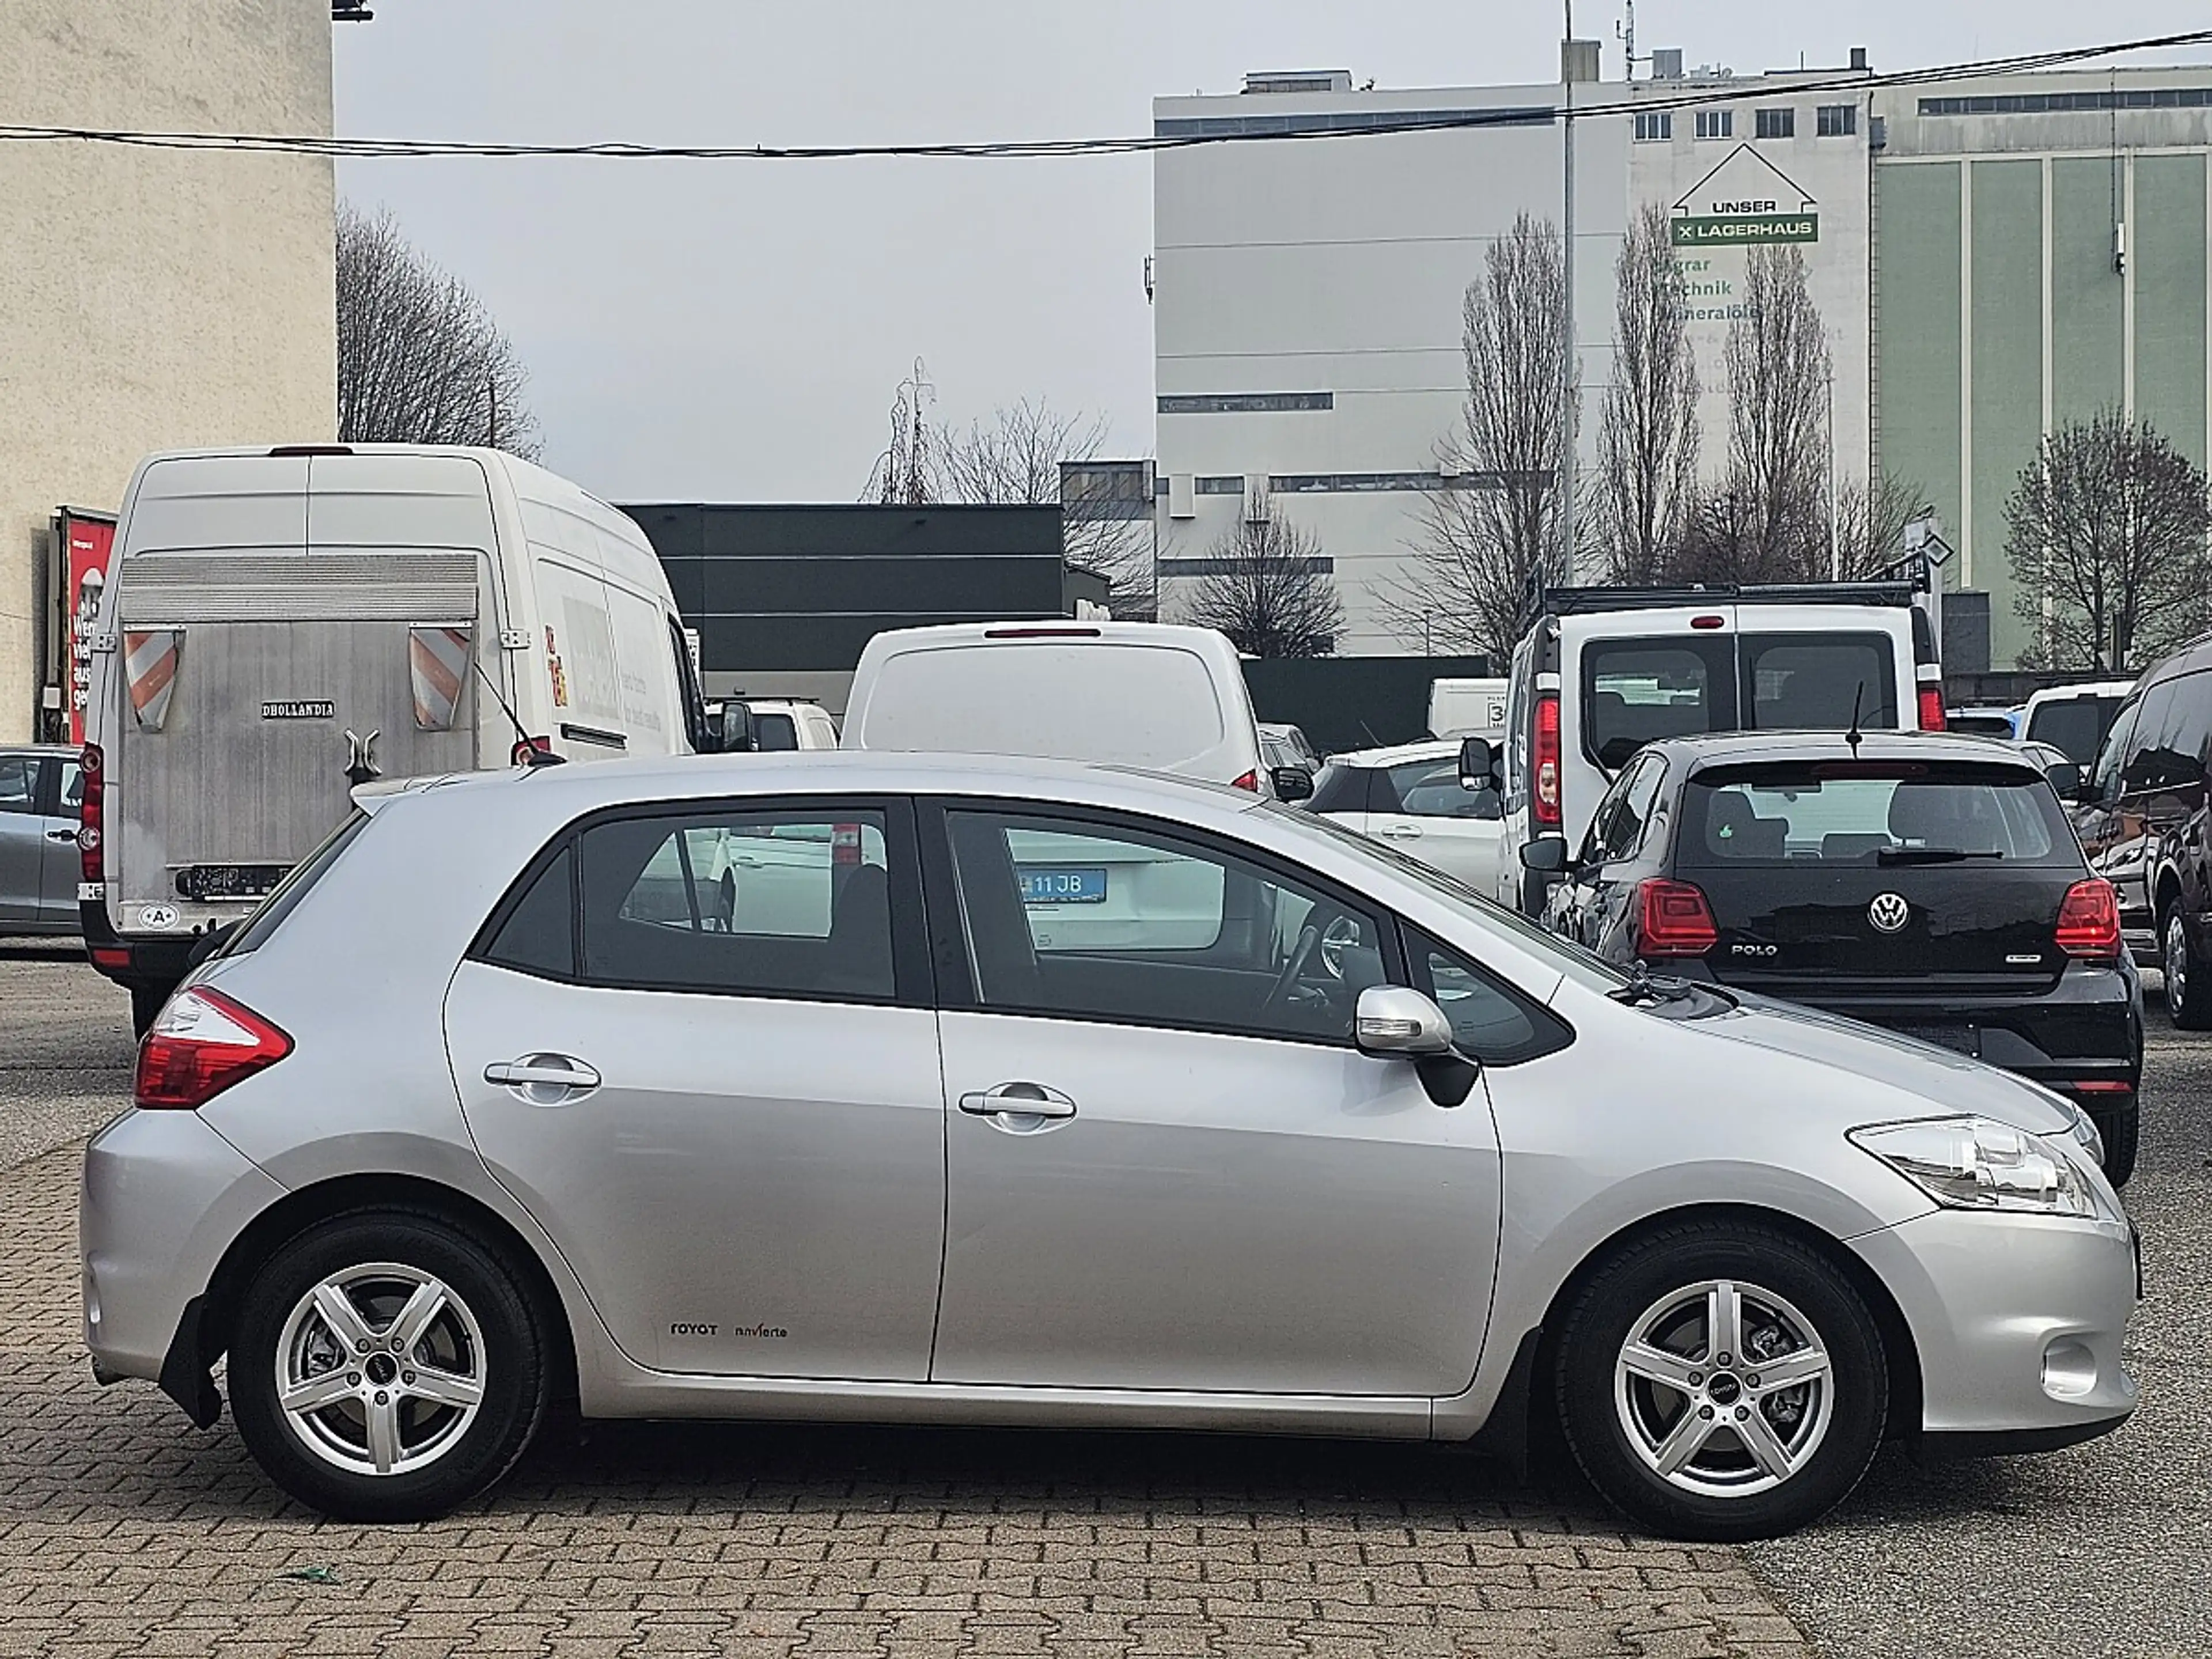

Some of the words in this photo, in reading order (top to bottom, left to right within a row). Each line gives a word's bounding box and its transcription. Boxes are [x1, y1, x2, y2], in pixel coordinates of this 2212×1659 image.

[1712, 201, 1776, 213] UNSER
[1697, 222, 1812, 237] LAGERHAUS
[262, 703, 333, 717] DHOLLANDIA
[1056, 874, 1082, 893] JB
[152, 910, 165, 923] A
[1731, 945, 1778, 956] POLO
